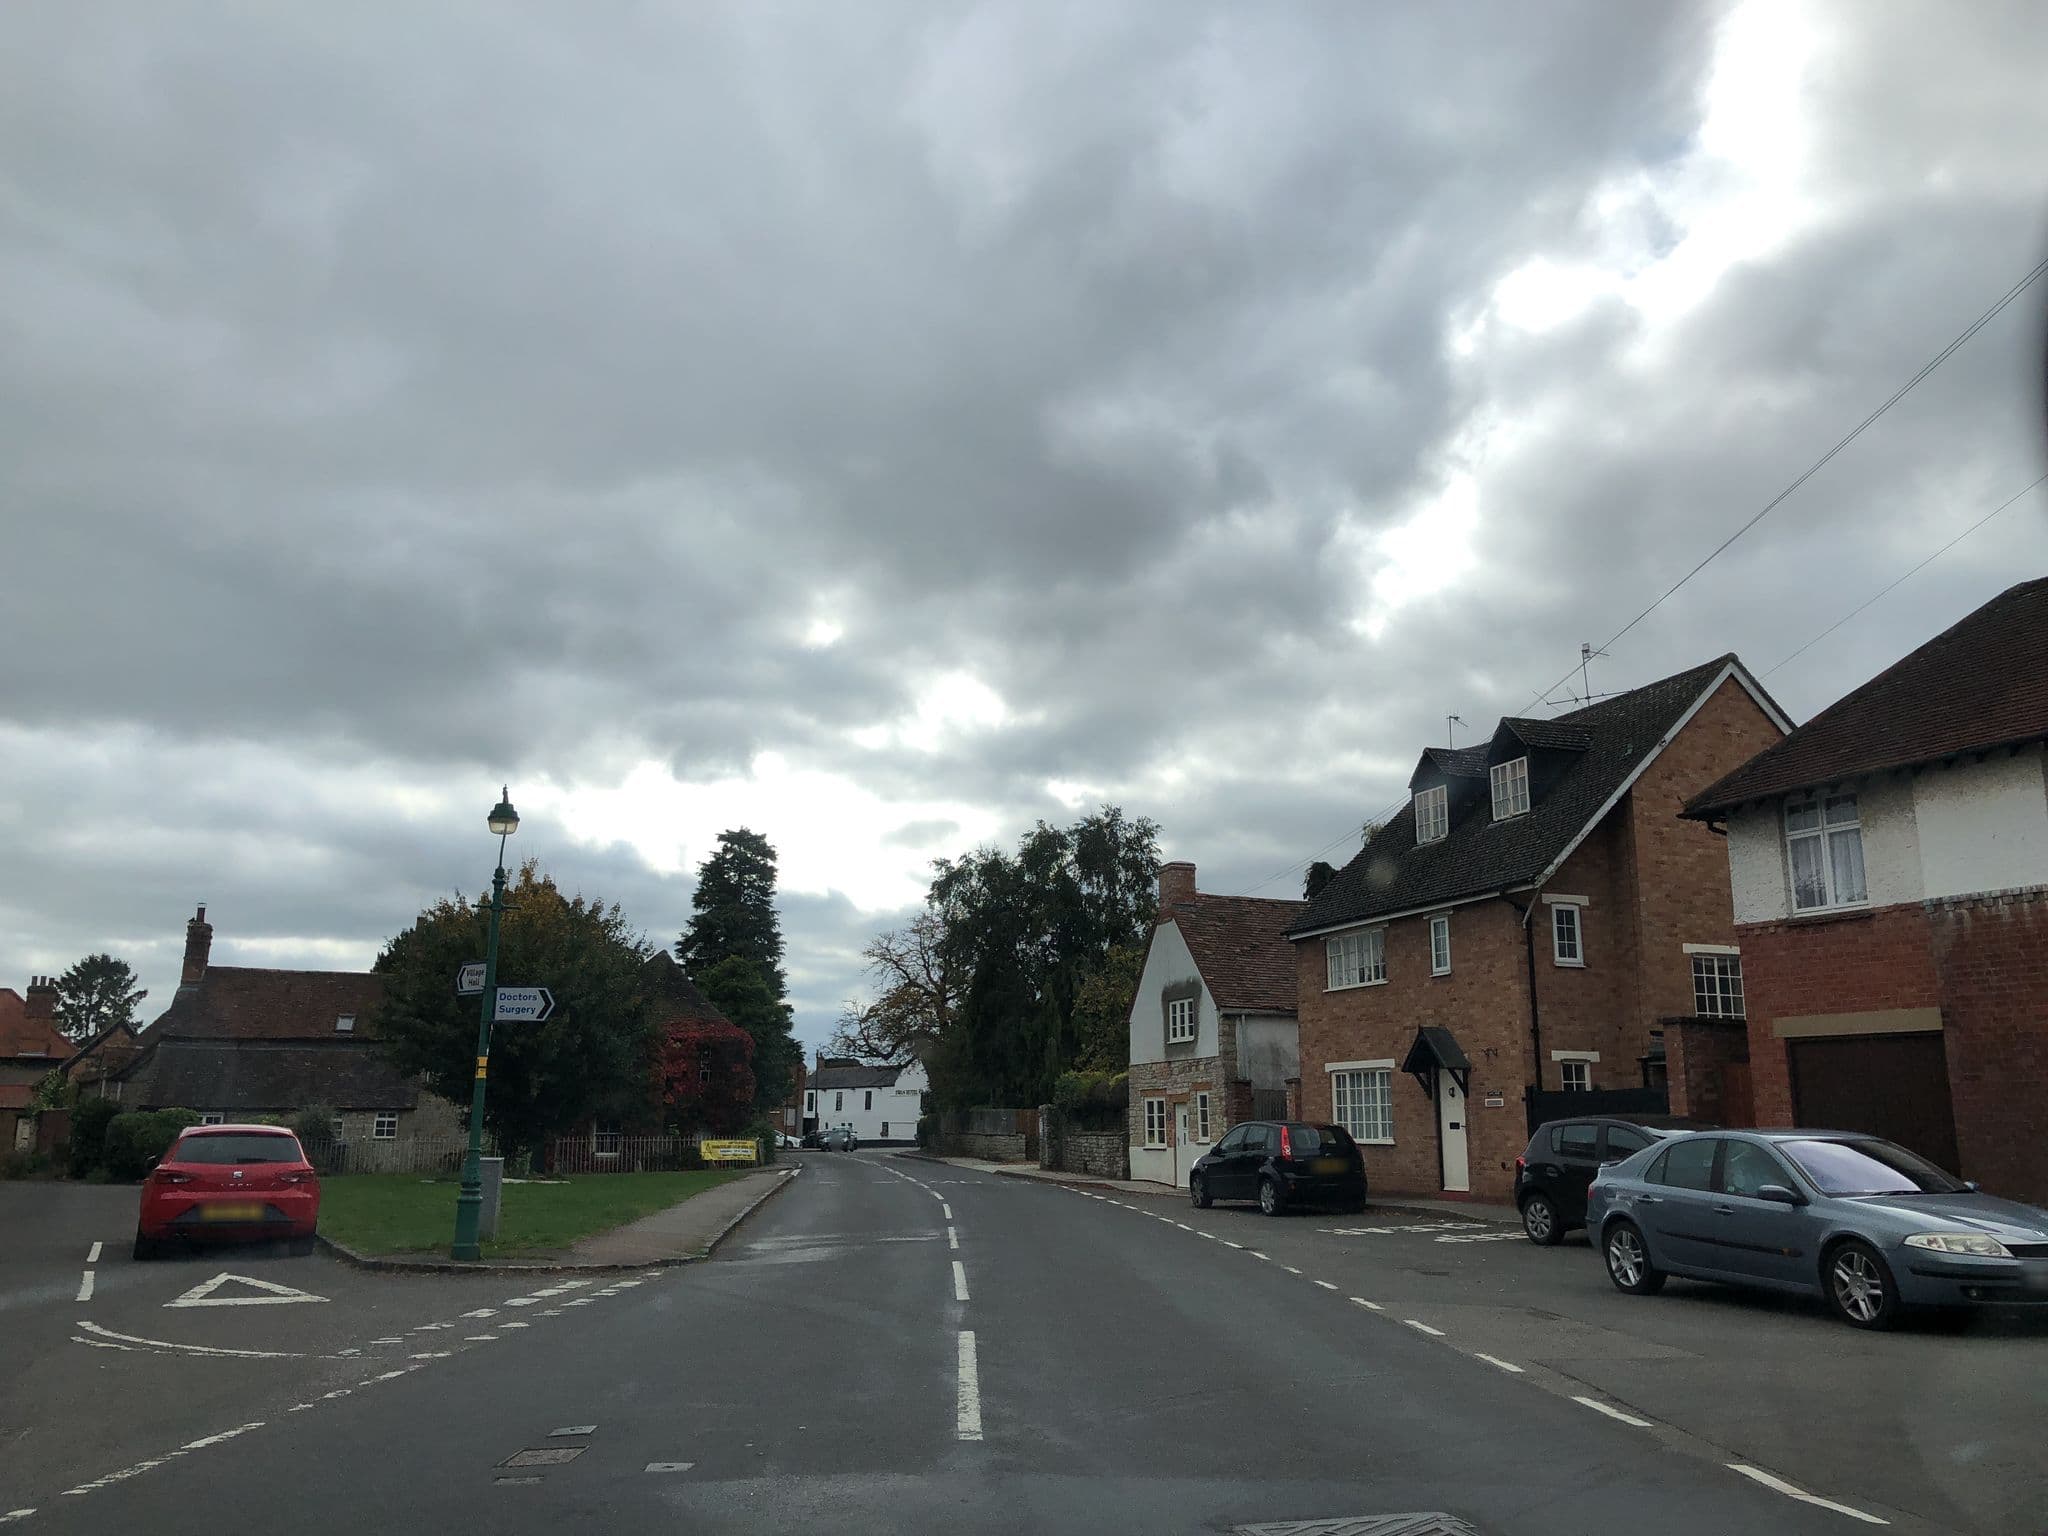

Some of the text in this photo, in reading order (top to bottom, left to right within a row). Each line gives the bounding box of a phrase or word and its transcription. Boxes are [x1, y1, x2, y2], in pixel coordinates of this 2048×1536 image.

[467, 968, 484, 977] Village
[468, 978, 480, 986] Hall
[499, 993, 537, 1001] Doctors
[499, 1005, 536, 1014] Surgery
